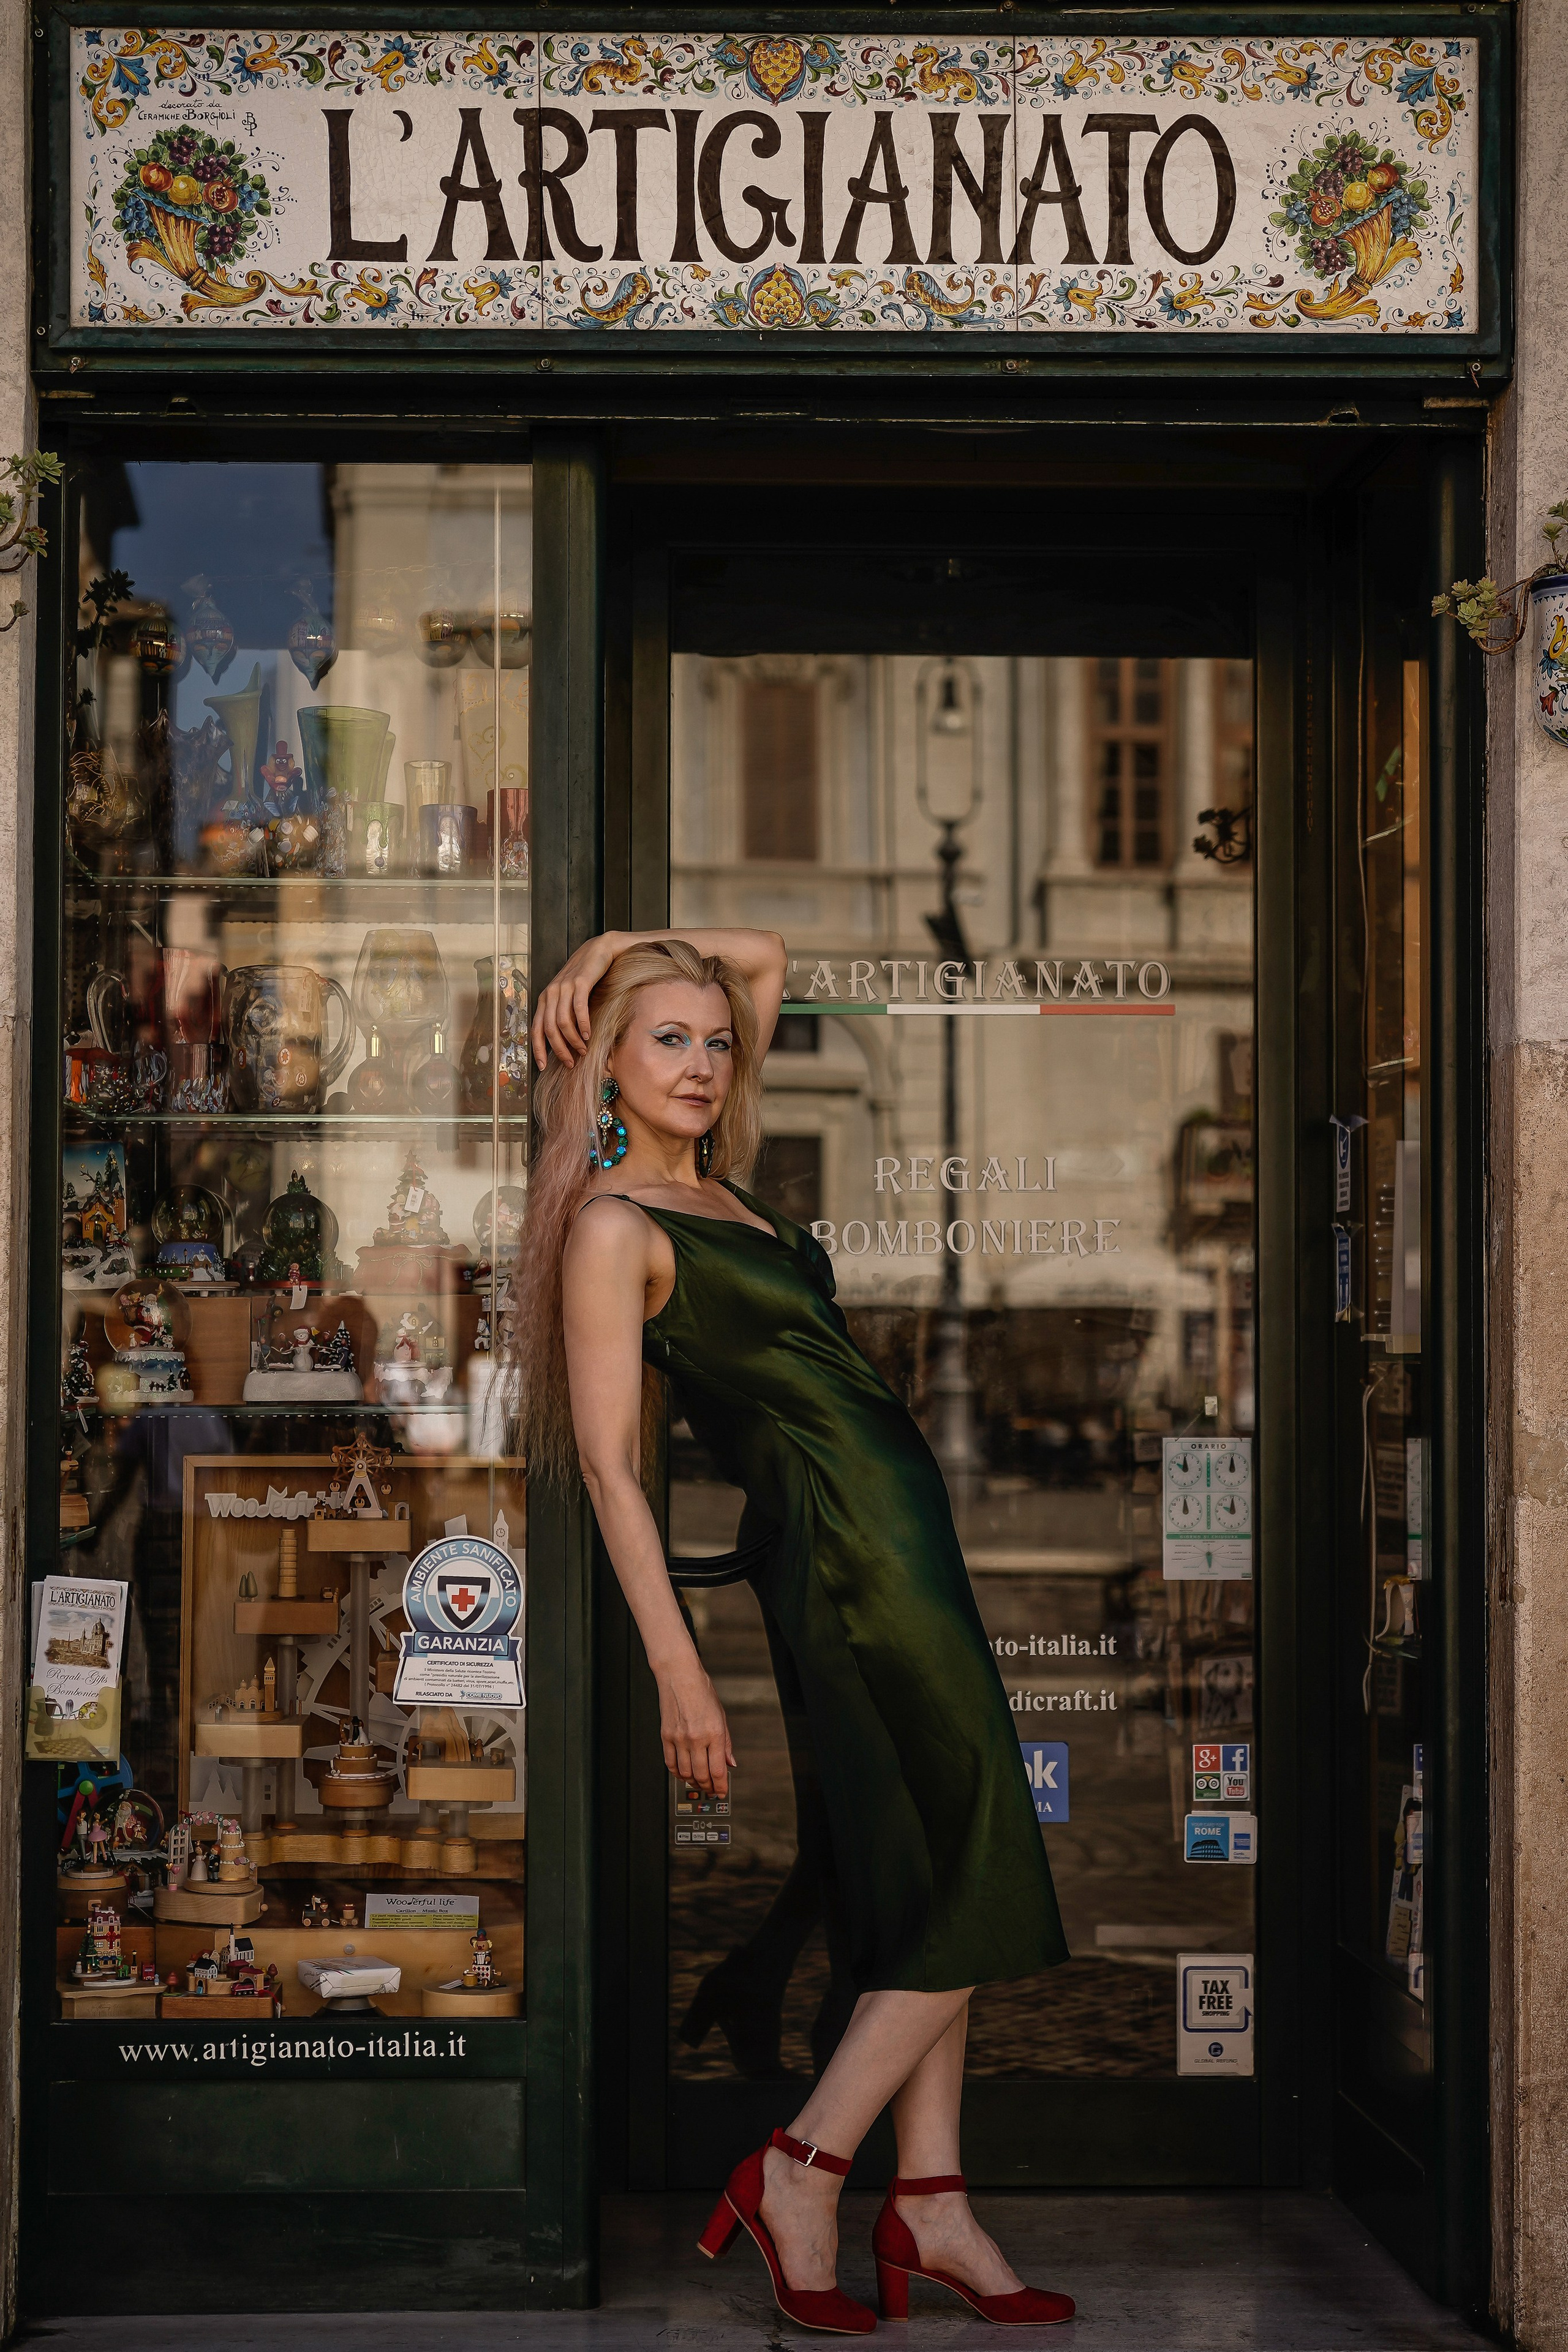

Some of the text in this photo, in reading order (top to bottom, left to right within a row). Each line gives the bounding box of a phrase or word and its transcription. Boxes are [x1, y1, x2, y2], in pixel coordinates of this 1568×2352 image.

[159, 99, 222, 108] decorato da
[138, 110, 180, 121] CERAMICHE
[321, 107, 1236, 265] L'ARTIGIANATO
[782, 960, 1171, 1003] 'ARTIGIANATO
[873, 1156, 1058, 1197] REGALI
[809, 1219, 1122, 1259] BOMBONIERE
[410, 1543, 516, 1607] AMBIENTE SANIFICATO
[50, 1591, 115, 1608] L'ARTIGIANATO
[418, 1635, 505, 1651] GARANZIA
[988, 1634, 1117, 1657] to-italia.it
[47, 1683, 99, 1698] Bombonier
[1009, 1690, 1118, 1712] dicraft.it
[1227, 1776, 1243, 1786] You
[1227, 1787, 1244, 1796] Tube
[1202, 1980, 1230, 1994] TAX
[1199, 1996, 1233, 2010] FREE
[119, 2031, 467, 2067] www.artigianato-italia.it
